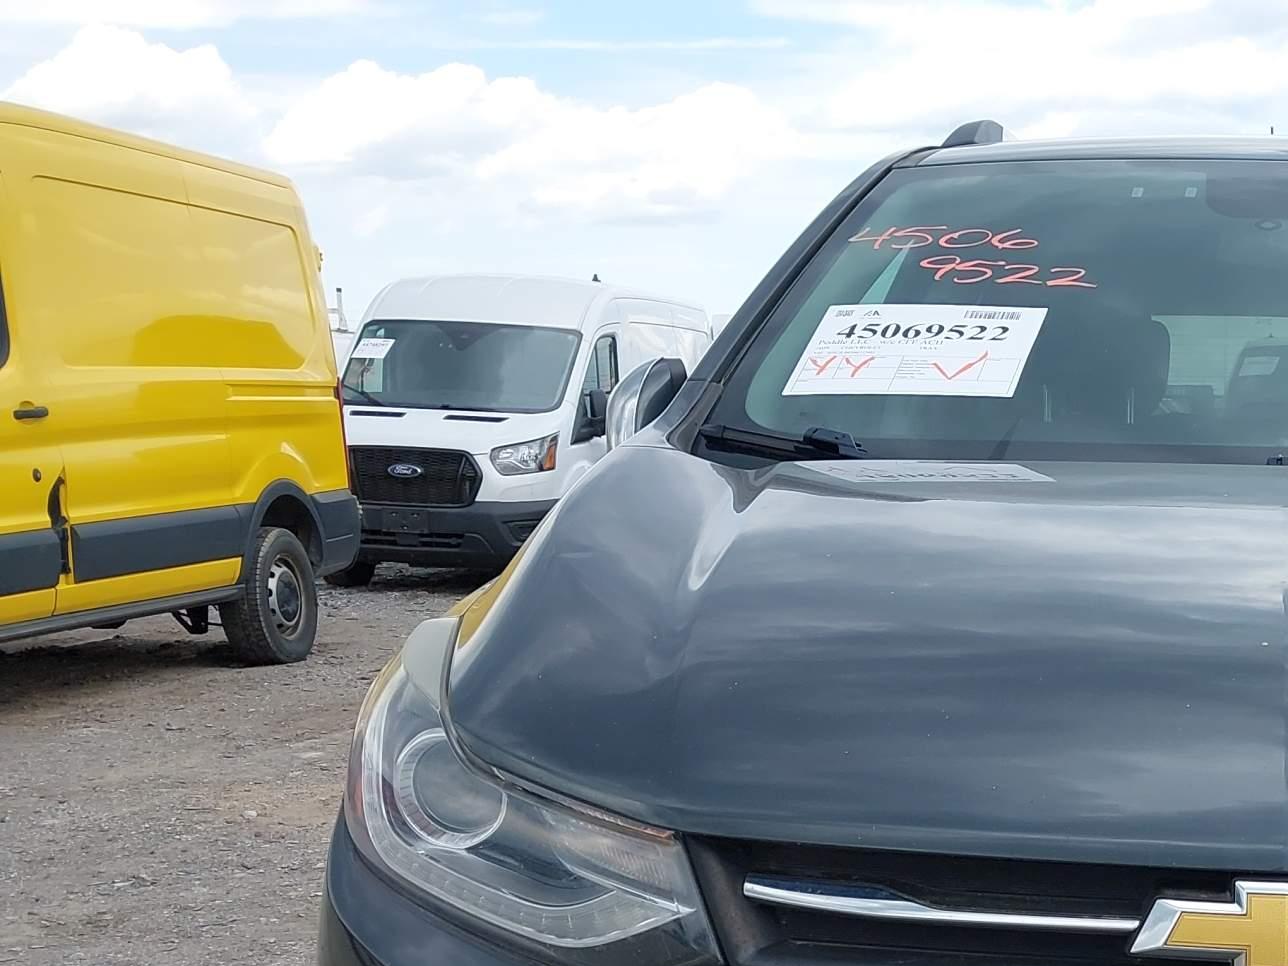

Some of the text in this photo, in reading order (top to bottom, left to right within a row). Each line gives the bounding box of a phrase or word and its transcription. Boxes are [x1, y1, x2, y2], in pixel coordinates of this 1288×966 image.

[848, 226, 1038, 250] 4506
[919, 255, 1098, 288] 9522
[837, 323, 1010, 341] 45069522
